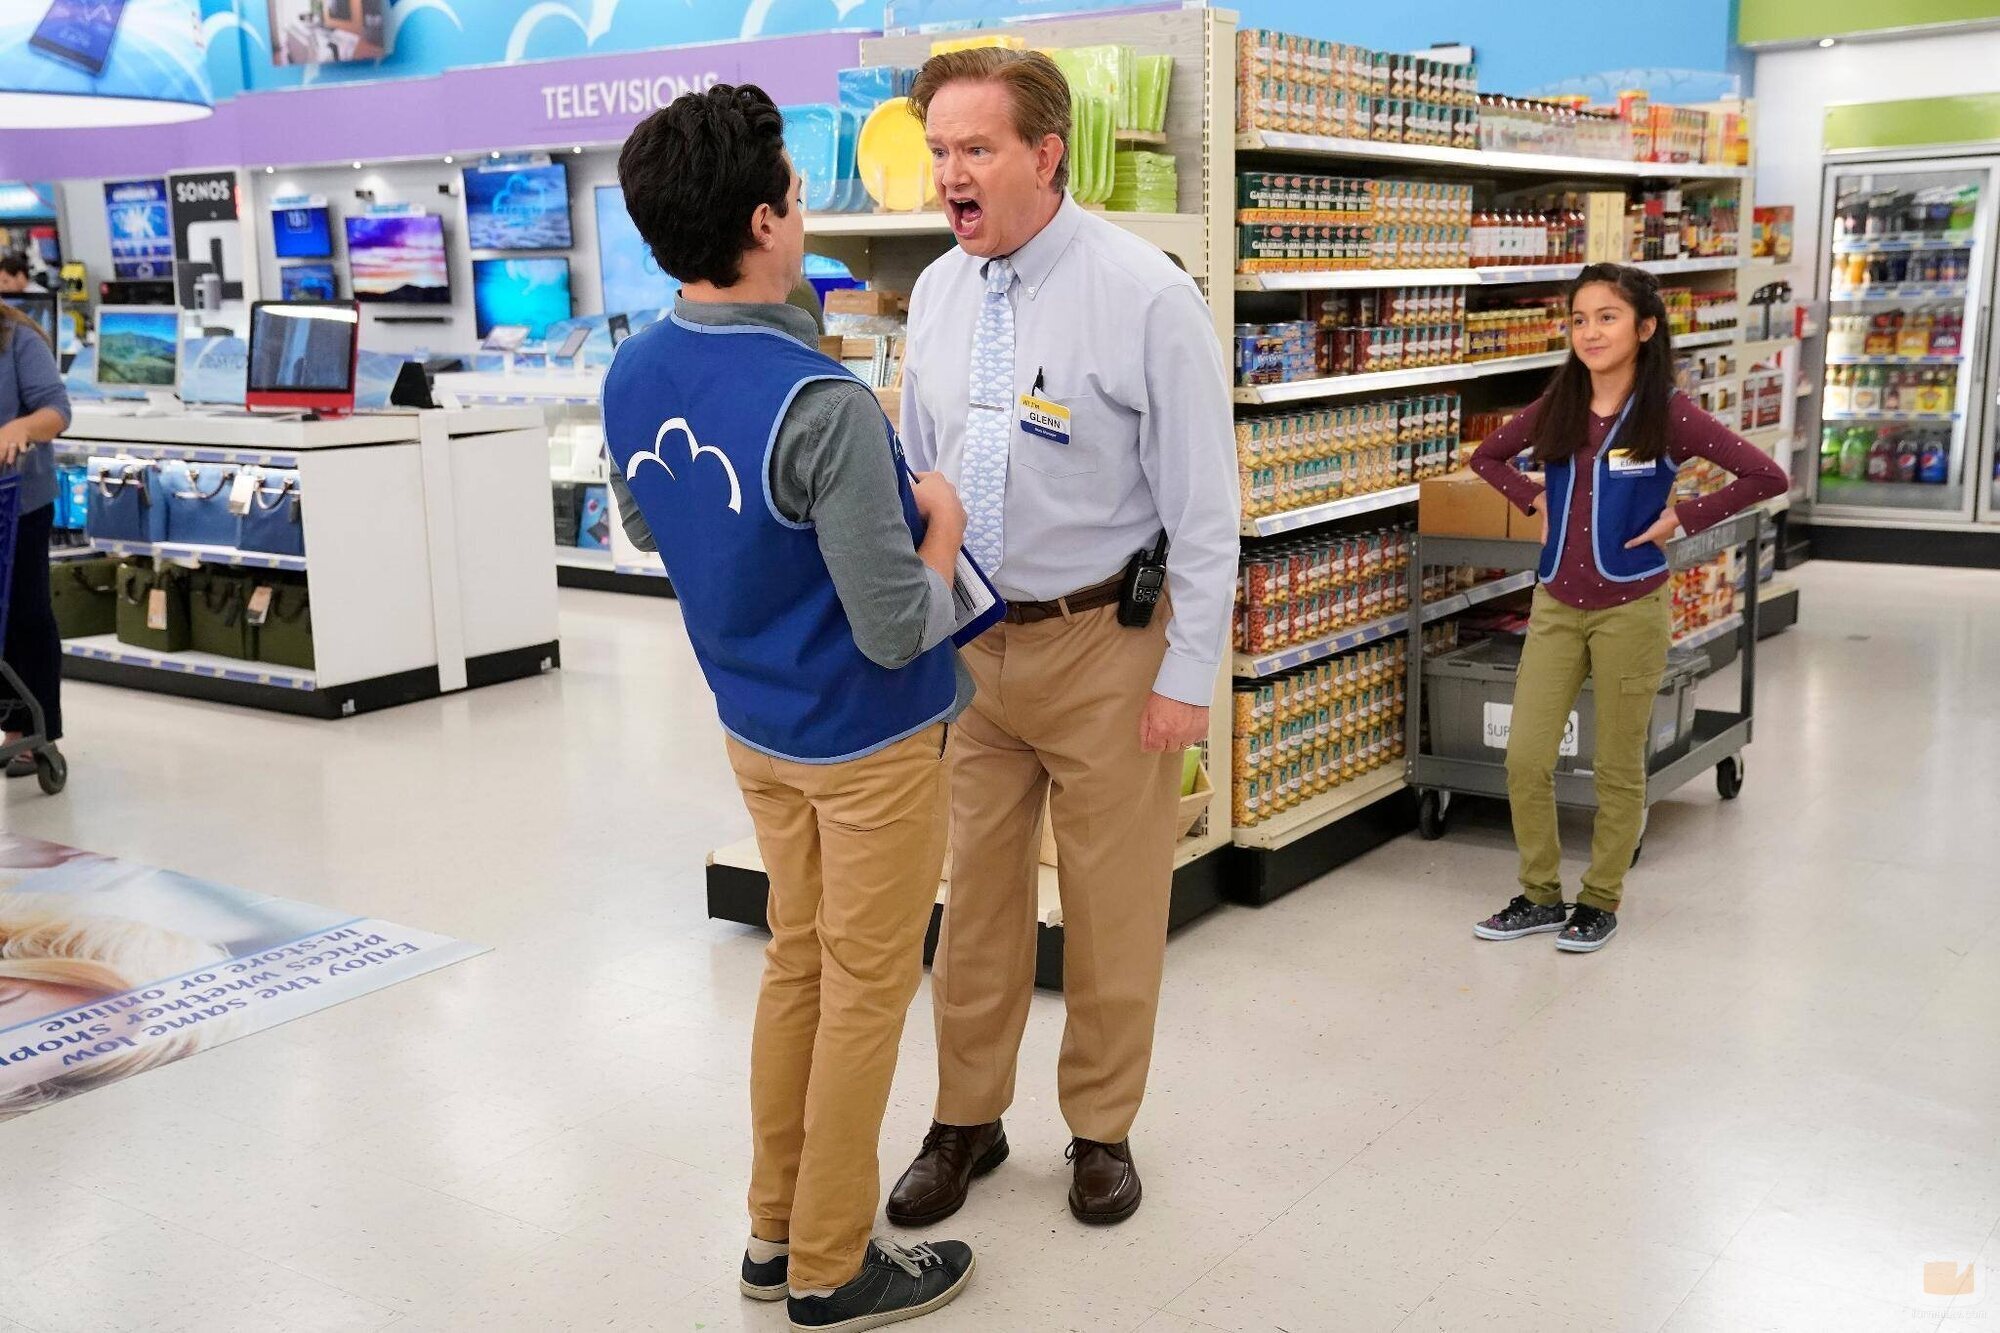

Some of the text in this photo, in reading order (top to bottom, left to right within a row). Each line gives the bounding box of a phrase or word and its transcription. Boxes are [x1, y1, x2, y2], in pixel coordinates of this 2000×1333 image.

[176, 180, 230, 203] SONOS
[1029, 412, 1061, 429] GLENN
[286, 934, 388, 971] prices
[39, 928, 364, 1032] in-store or online
[126, 970, 281, 1025] whether
[62, 942, 420, 1066] Enjoy the same low
